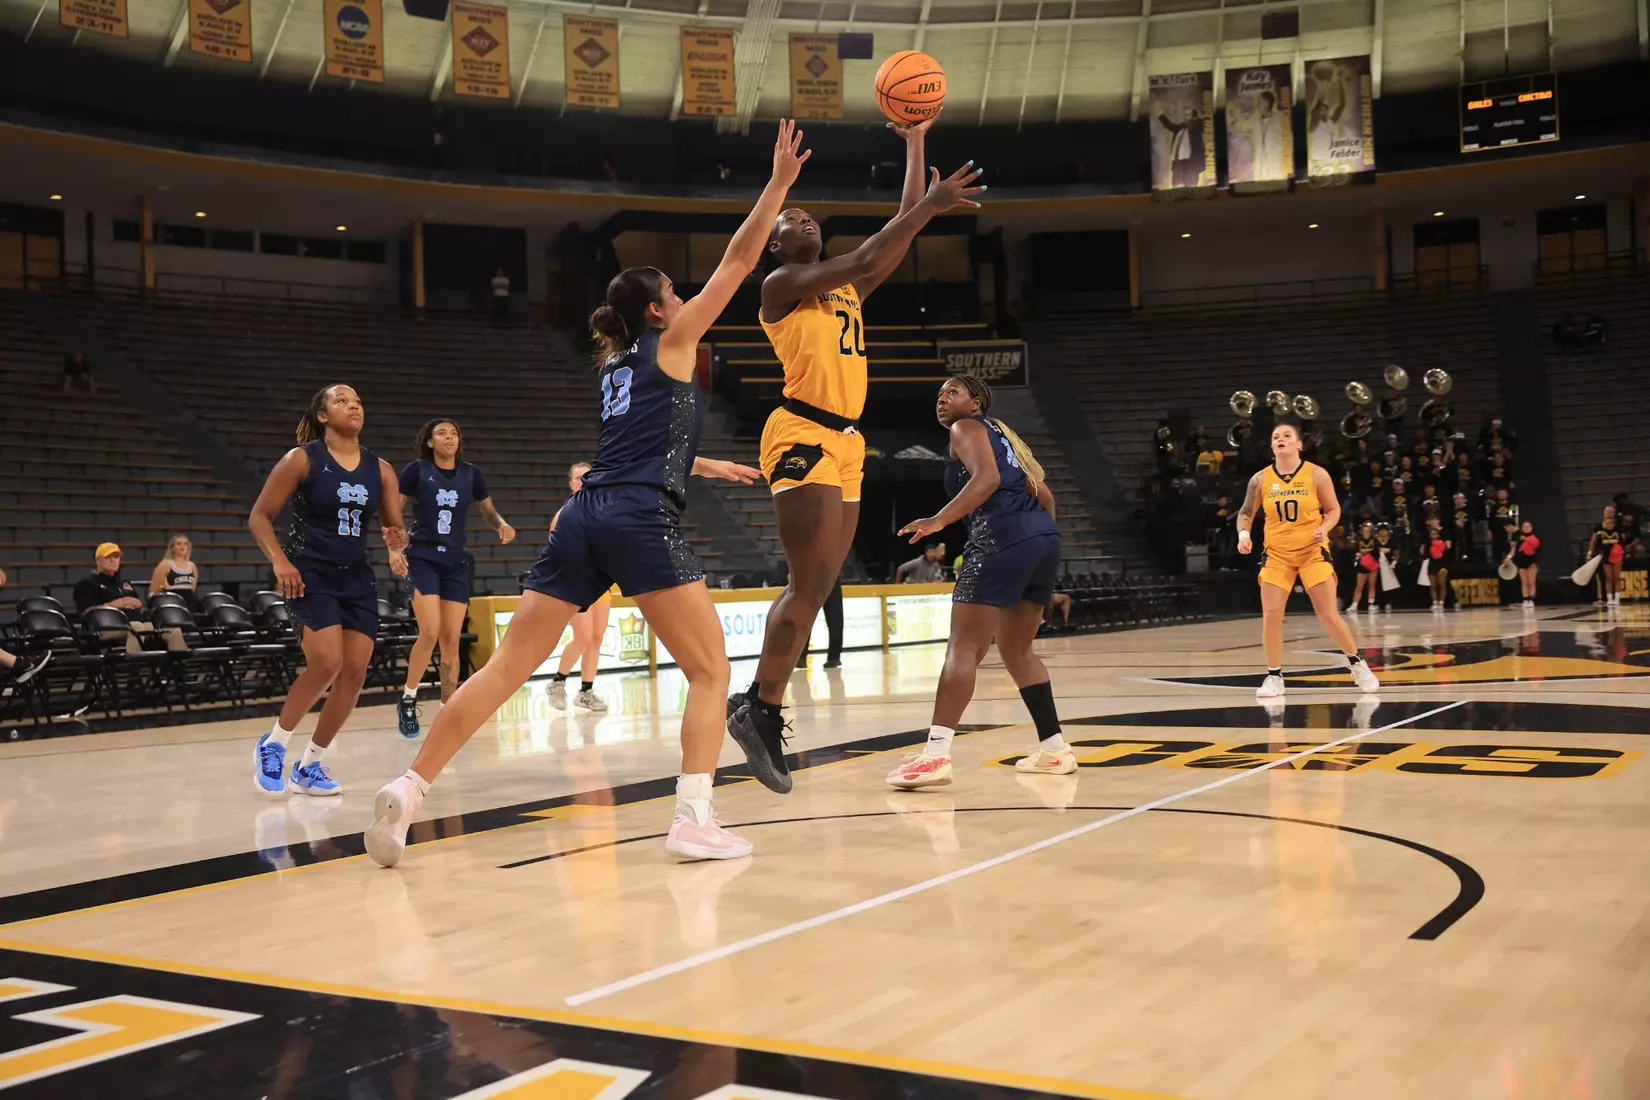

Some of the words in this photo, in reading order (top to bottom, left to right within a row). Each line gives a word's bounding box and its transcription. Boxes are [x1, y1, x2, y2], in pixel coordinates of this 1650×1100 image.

[468, 14, 492, 24] MISS
[340, 20, 368, 33] NCAA
[1245, 71, 1268, 83] Kay
[918, 81, 941, 94] EVO
[1331, 148, 1361, 159] Felder
[945, 351, 1022, 368] SOUTHERN
[965, 367, 996, 379] MISS
[601, 366, 634, 422] 13
[1267, 489, 1295, 498] SOUTHERN
[1274, 500, 1298, 522] 10
[337, 508, 363, 537] 11
[437, 509, 452, 534] 2
[724, 613, 768, 636] SOUT
